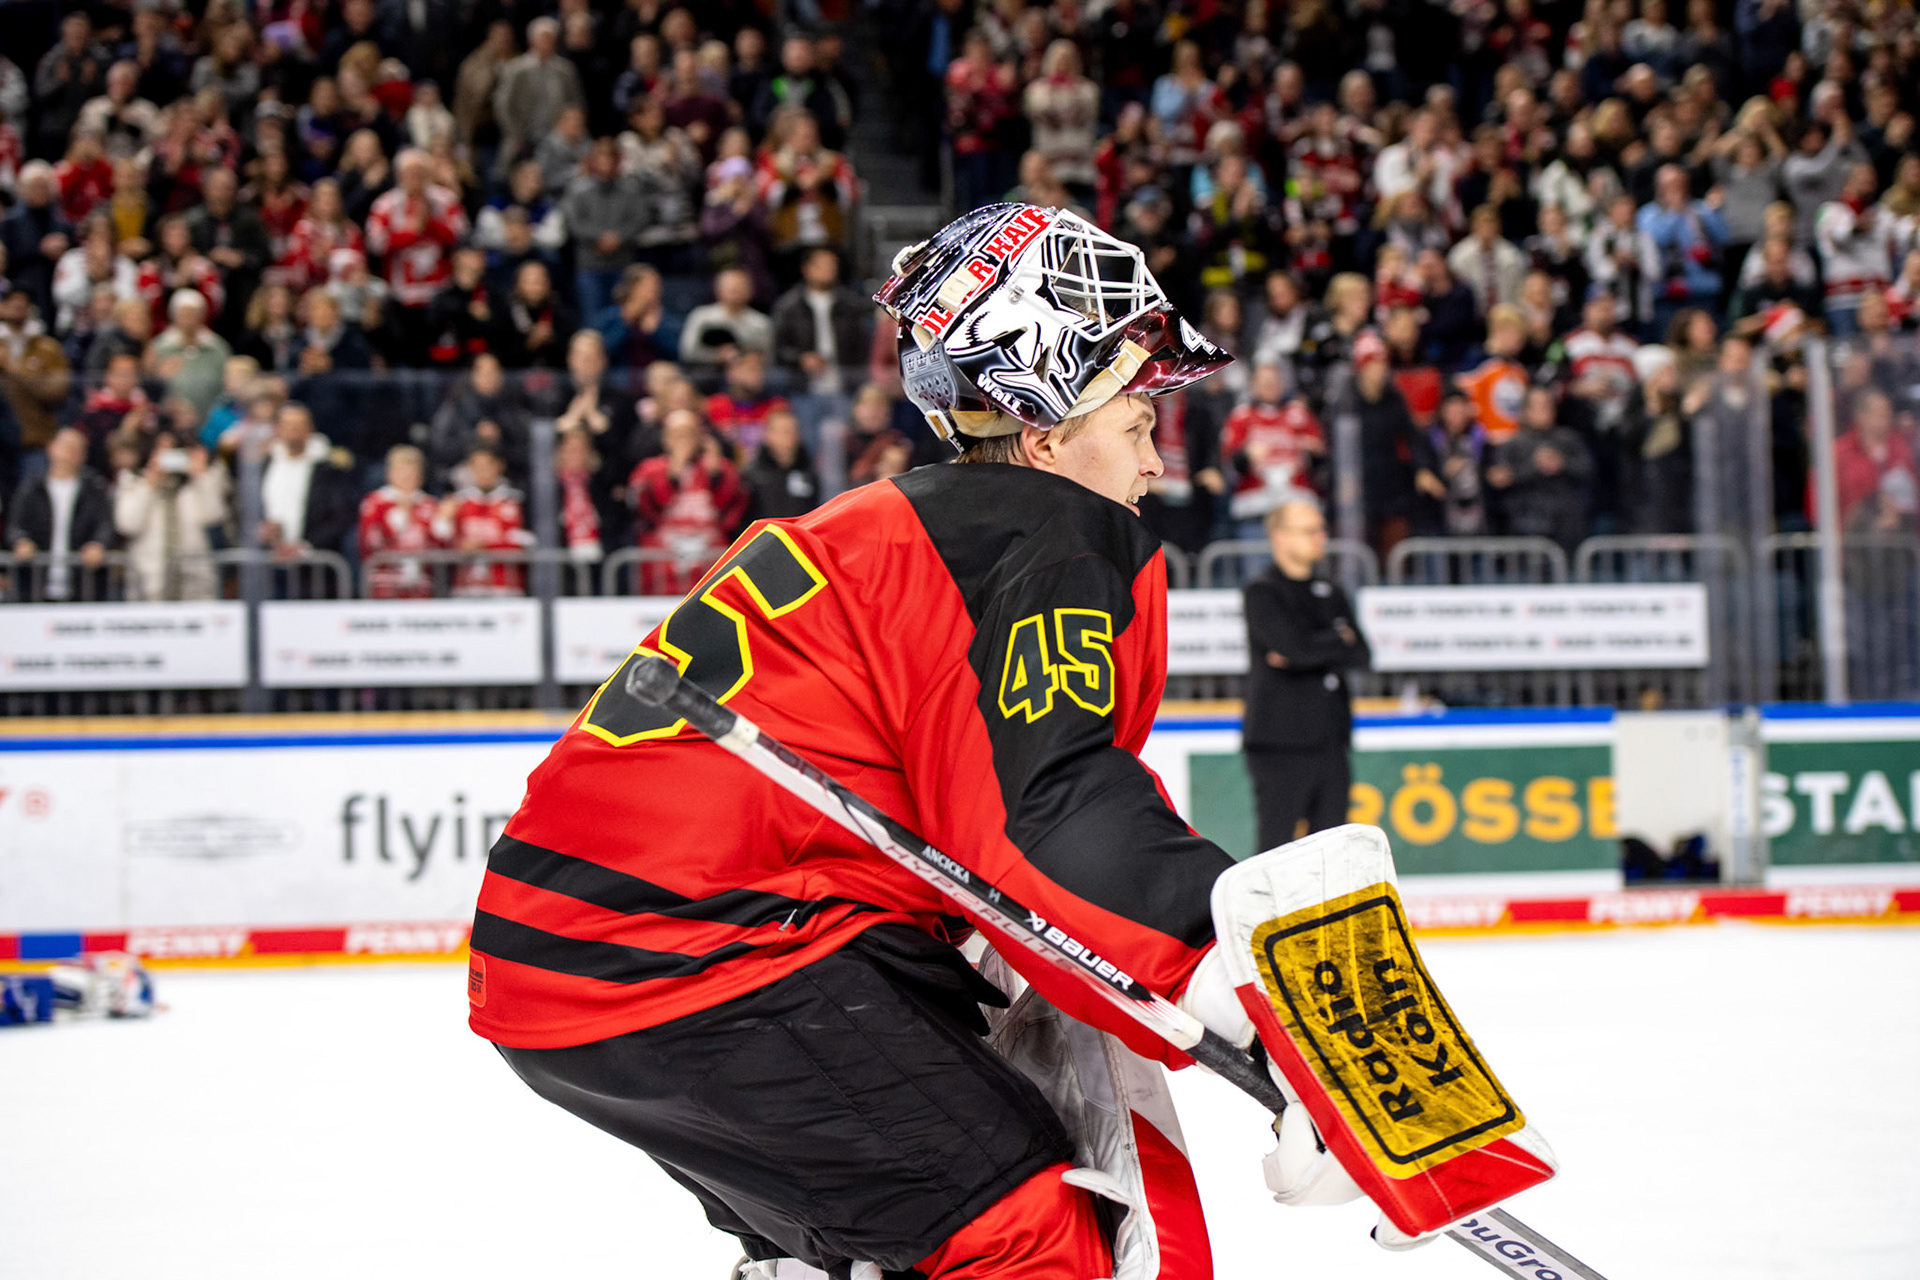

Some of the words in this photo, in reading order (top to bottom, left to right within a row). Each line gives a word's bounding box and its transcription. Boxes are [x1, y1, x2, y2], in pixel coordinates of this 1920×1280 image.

[997, 607, 1116, 724] 45
[1760, 769, 1920, 839] STA
[1314, 960, 1425, 1122] Radio
[1373, 957, 1464, 1087] Köln
